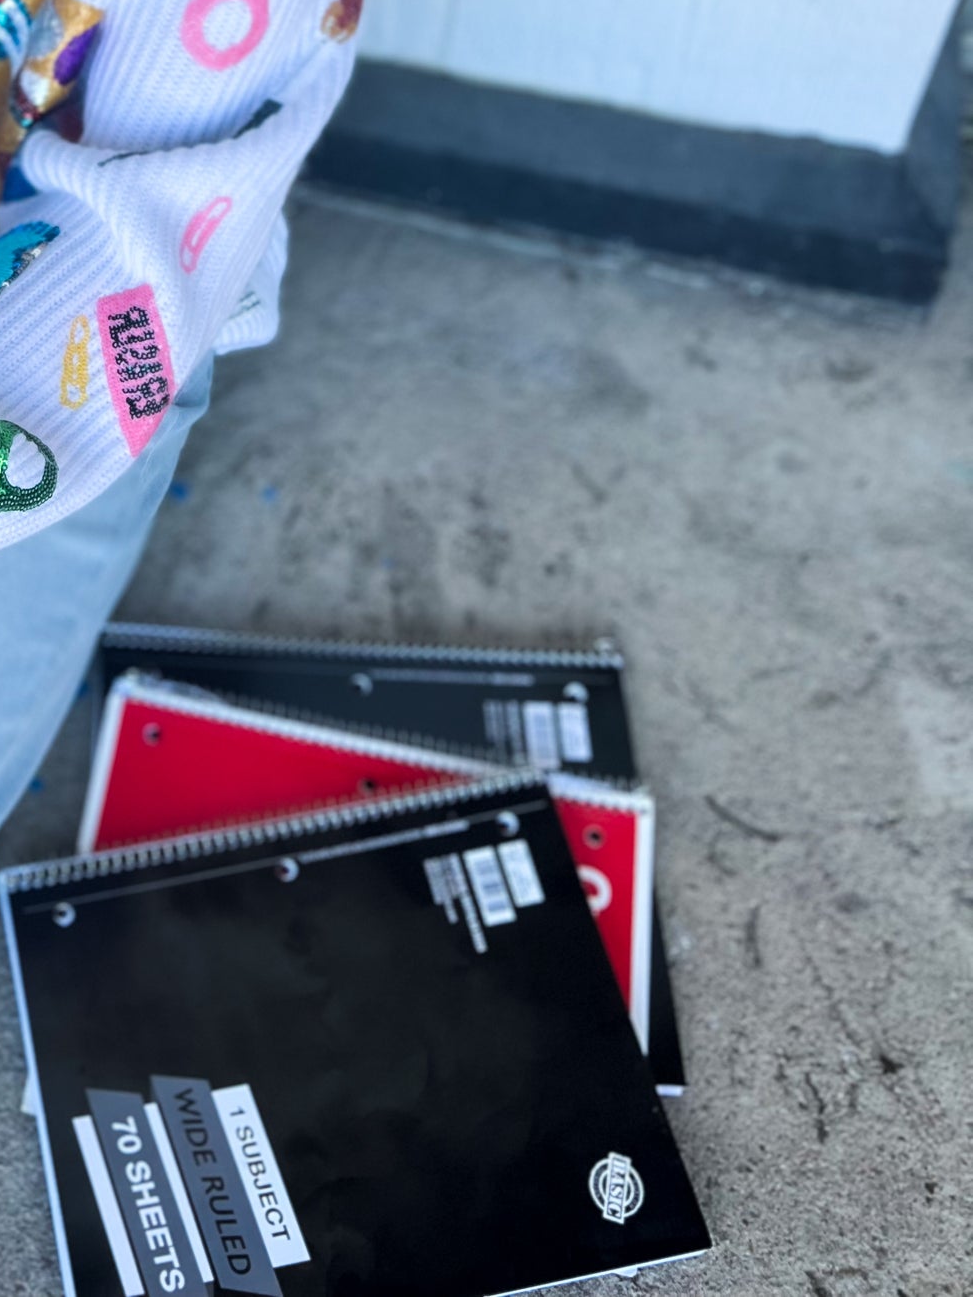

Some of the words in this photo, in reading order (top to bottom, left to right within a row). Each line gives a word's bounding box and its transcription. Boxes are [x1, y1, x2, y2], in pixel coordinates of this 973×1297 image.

[110, 1115, 143, 1155] 70
[229, 1105, 246, 1118] 1
[124, 1159, 186, 1293] SHEETS
[172, 1087, 218, 1167] WIDE
[200, 1175, 253, 1276] RULED
[235, 1124, 292, 1241] SUBJECT
[606, 1156, 629, 1220] BASIC
